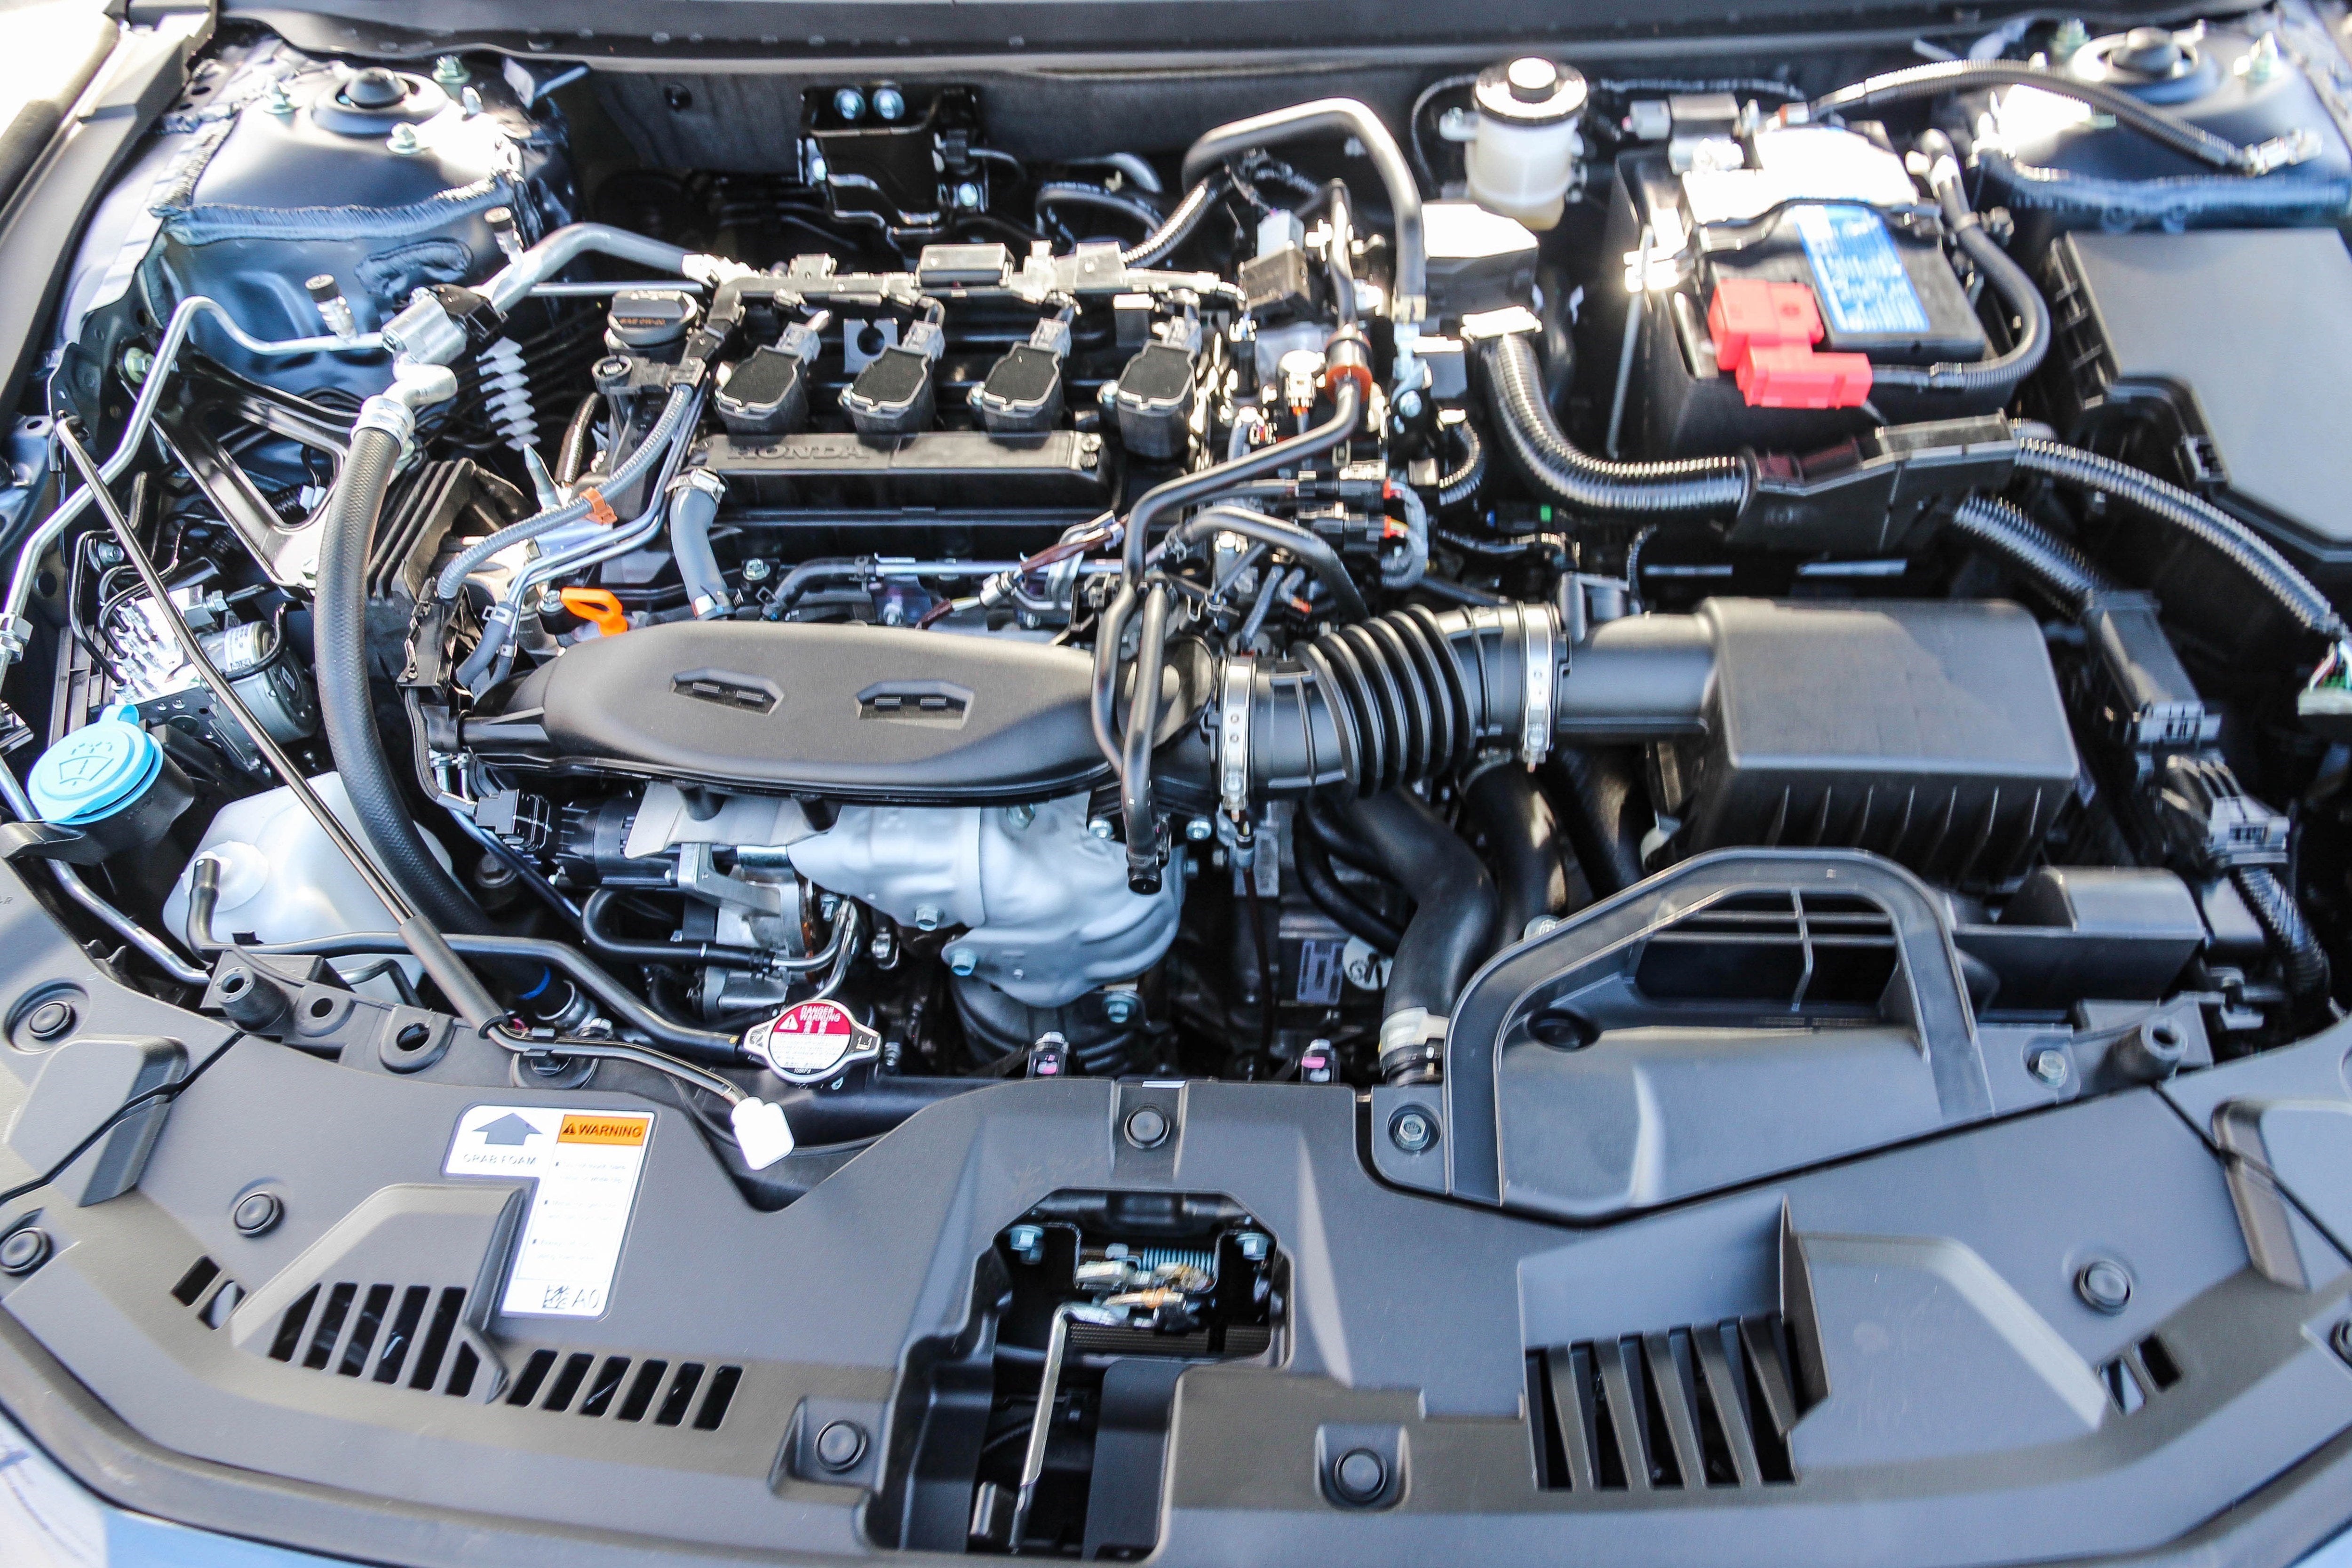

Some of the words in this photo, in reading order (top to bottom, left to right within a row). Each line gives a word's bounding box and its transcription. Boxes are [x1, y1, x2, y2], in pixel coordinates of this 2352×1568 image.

[727, 445, 870, 460] HONDA
[801, 1005, 834, 1014] DANGER
[579, 1124, 643, 1138] WARNING
